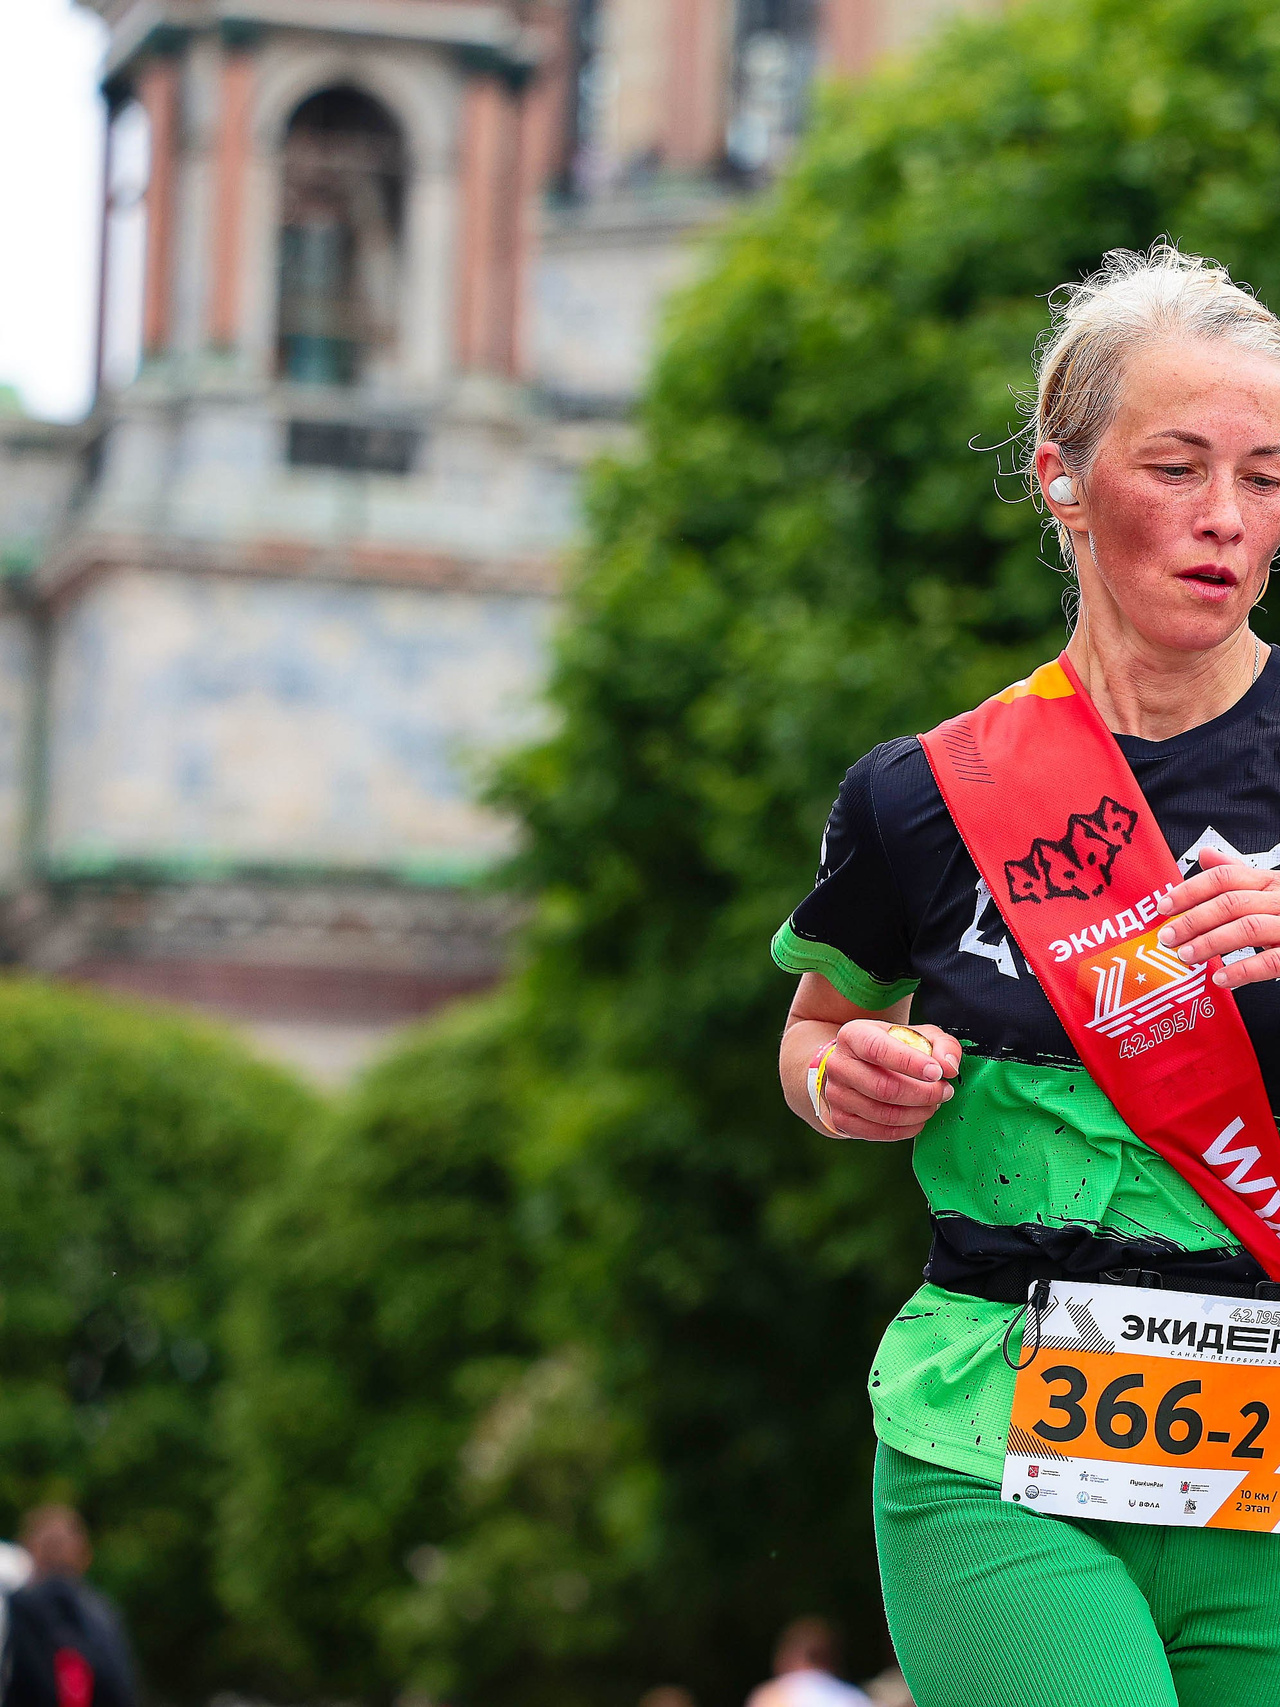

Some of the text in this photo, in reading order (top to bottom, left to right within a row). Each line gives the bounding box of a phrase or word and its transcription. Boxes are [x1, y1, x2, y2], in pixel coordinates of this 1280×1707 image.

[1119, 997, 1216, 1060] 42.195/6
[1032, 1365, 1270, 1459] 366-2
[1235, 1501, 1271, 1514] 2 этап
[1240, 1489, 1252, 1500] 10
[1254, 1492, 1270, 1501] км
